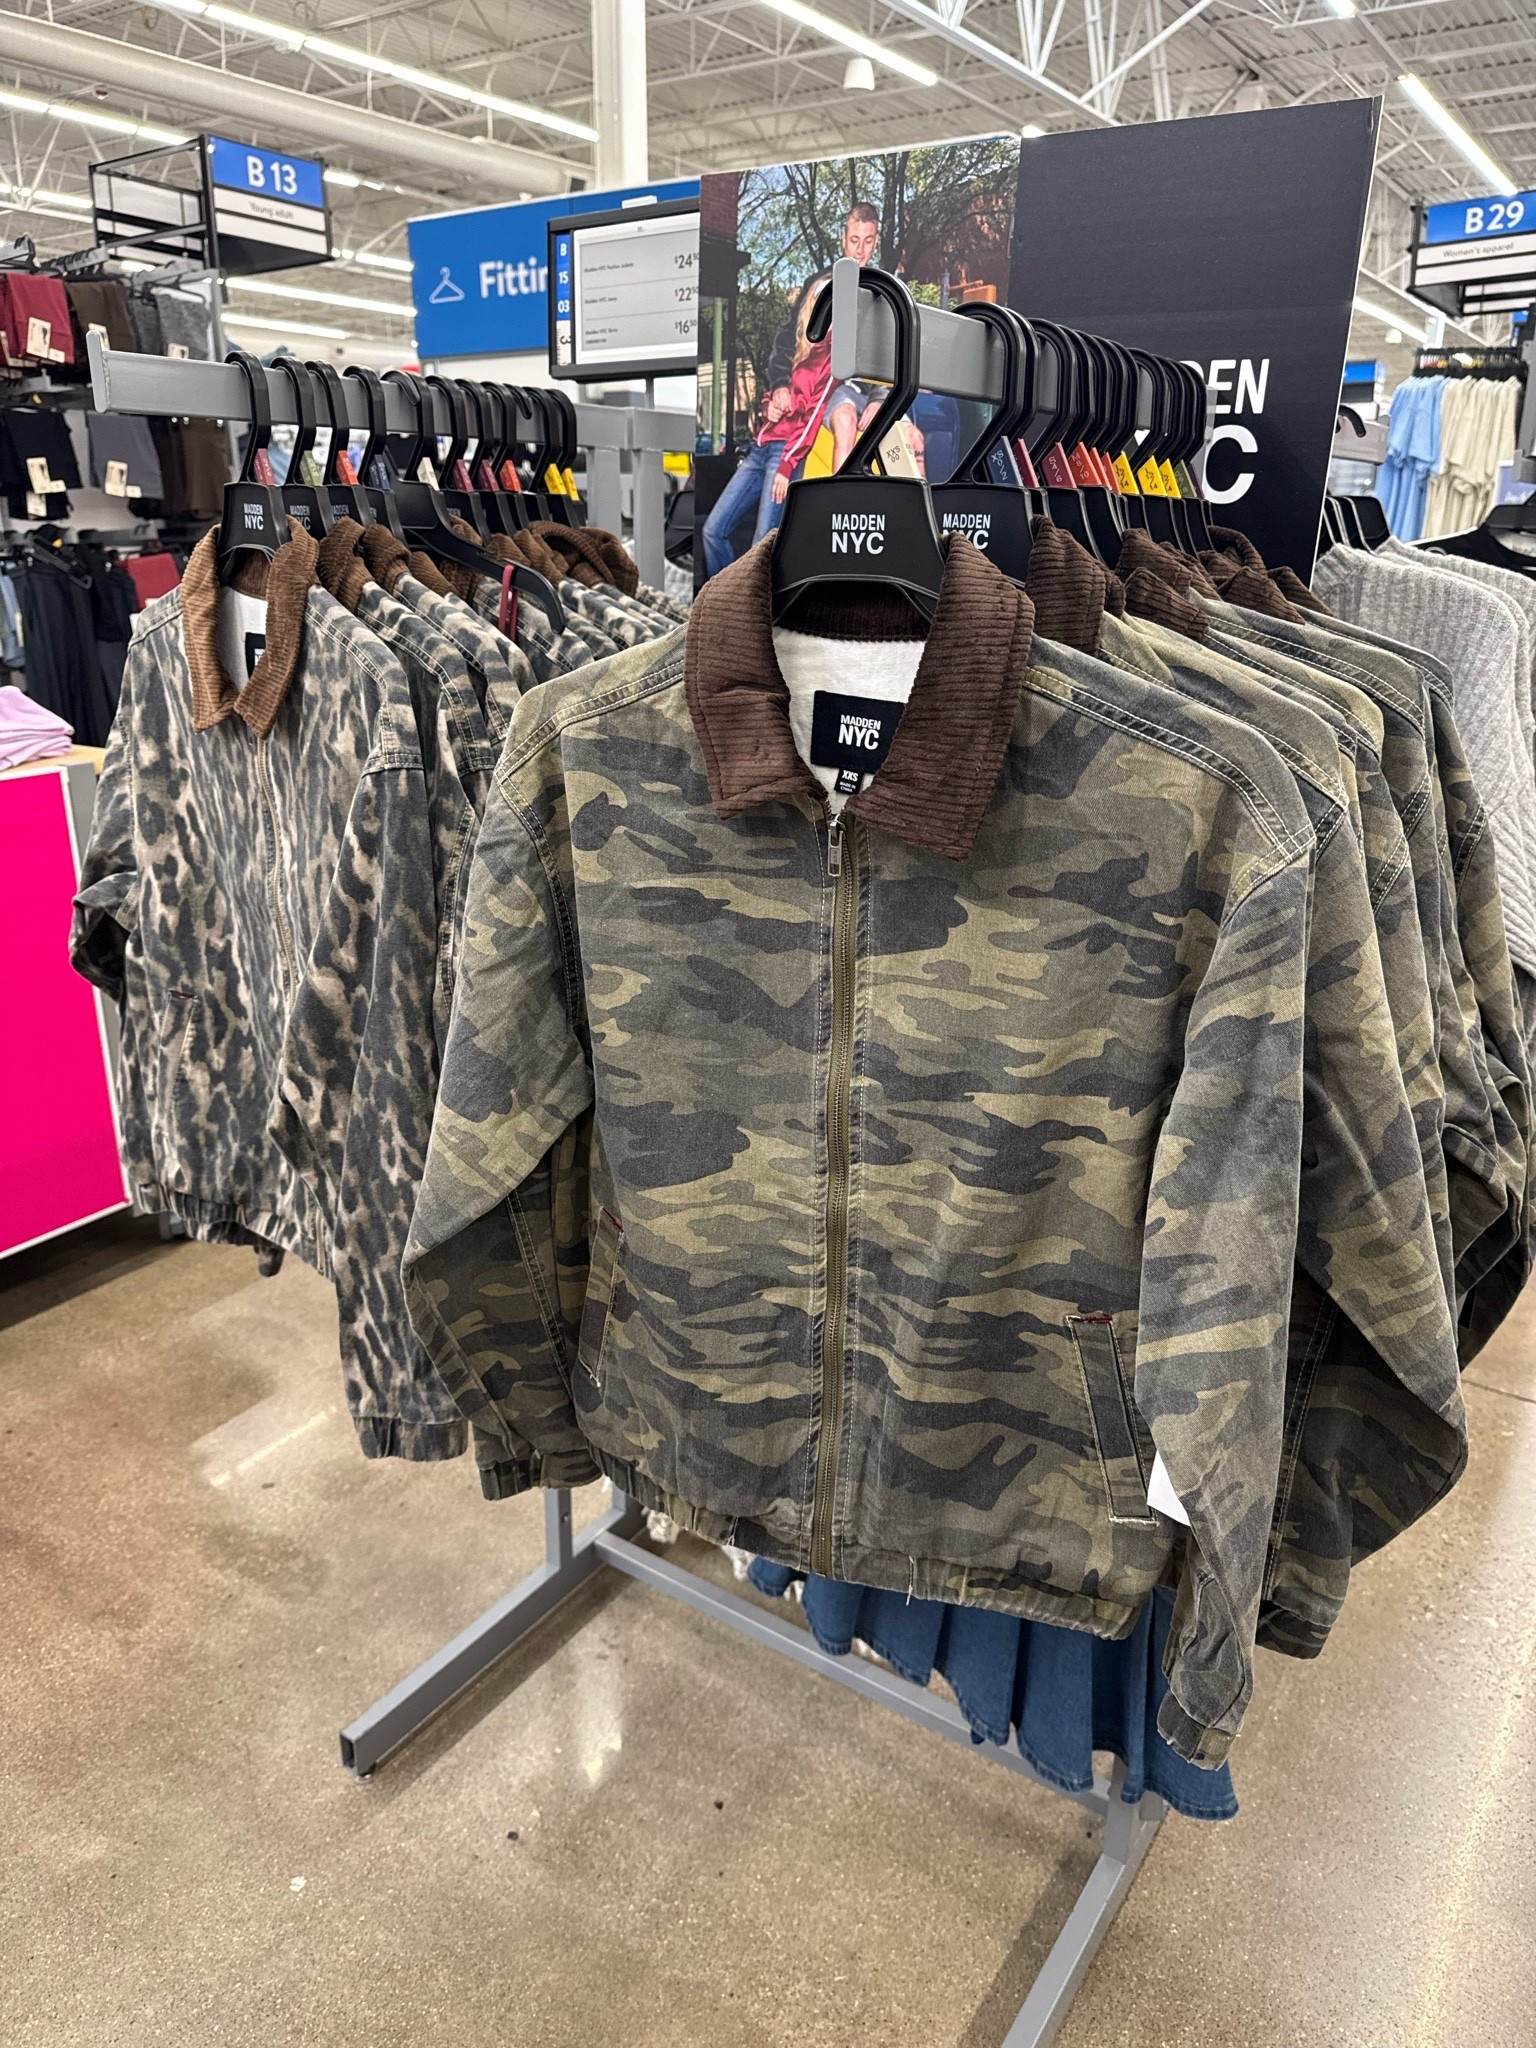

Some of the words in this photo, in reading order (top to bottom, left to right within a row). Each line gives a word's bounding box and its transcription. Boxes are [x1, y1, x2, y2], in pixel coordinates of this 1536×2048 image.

[246, 155, 265, 188] B
[270, 161, 298, 195] 13
[1464, 207, 1484, 235] B
[1486, 200, 1525, 232] 29
[560, 243, 567, 256] B
[558, 271, 569, 284] 15
[557, 299, 570, 313] 03
[1178, 357, 1271, 415] EN
[886, 445, 901, 458] XXS
[991, 449, 1004, 463] XS
[243, 503, 263, 515] MADDEN
[244, 514, 264, 531] NYC
[831, 513, 886, 532] MADDEN
[942, 513, 991, 529] MADDEN
[831, 531, 885, 555] NYC
[840, 714, 881, 731] MADDEN
[838, 723, 880, 750] NYC
[842, 769, 859, 782] XXS
